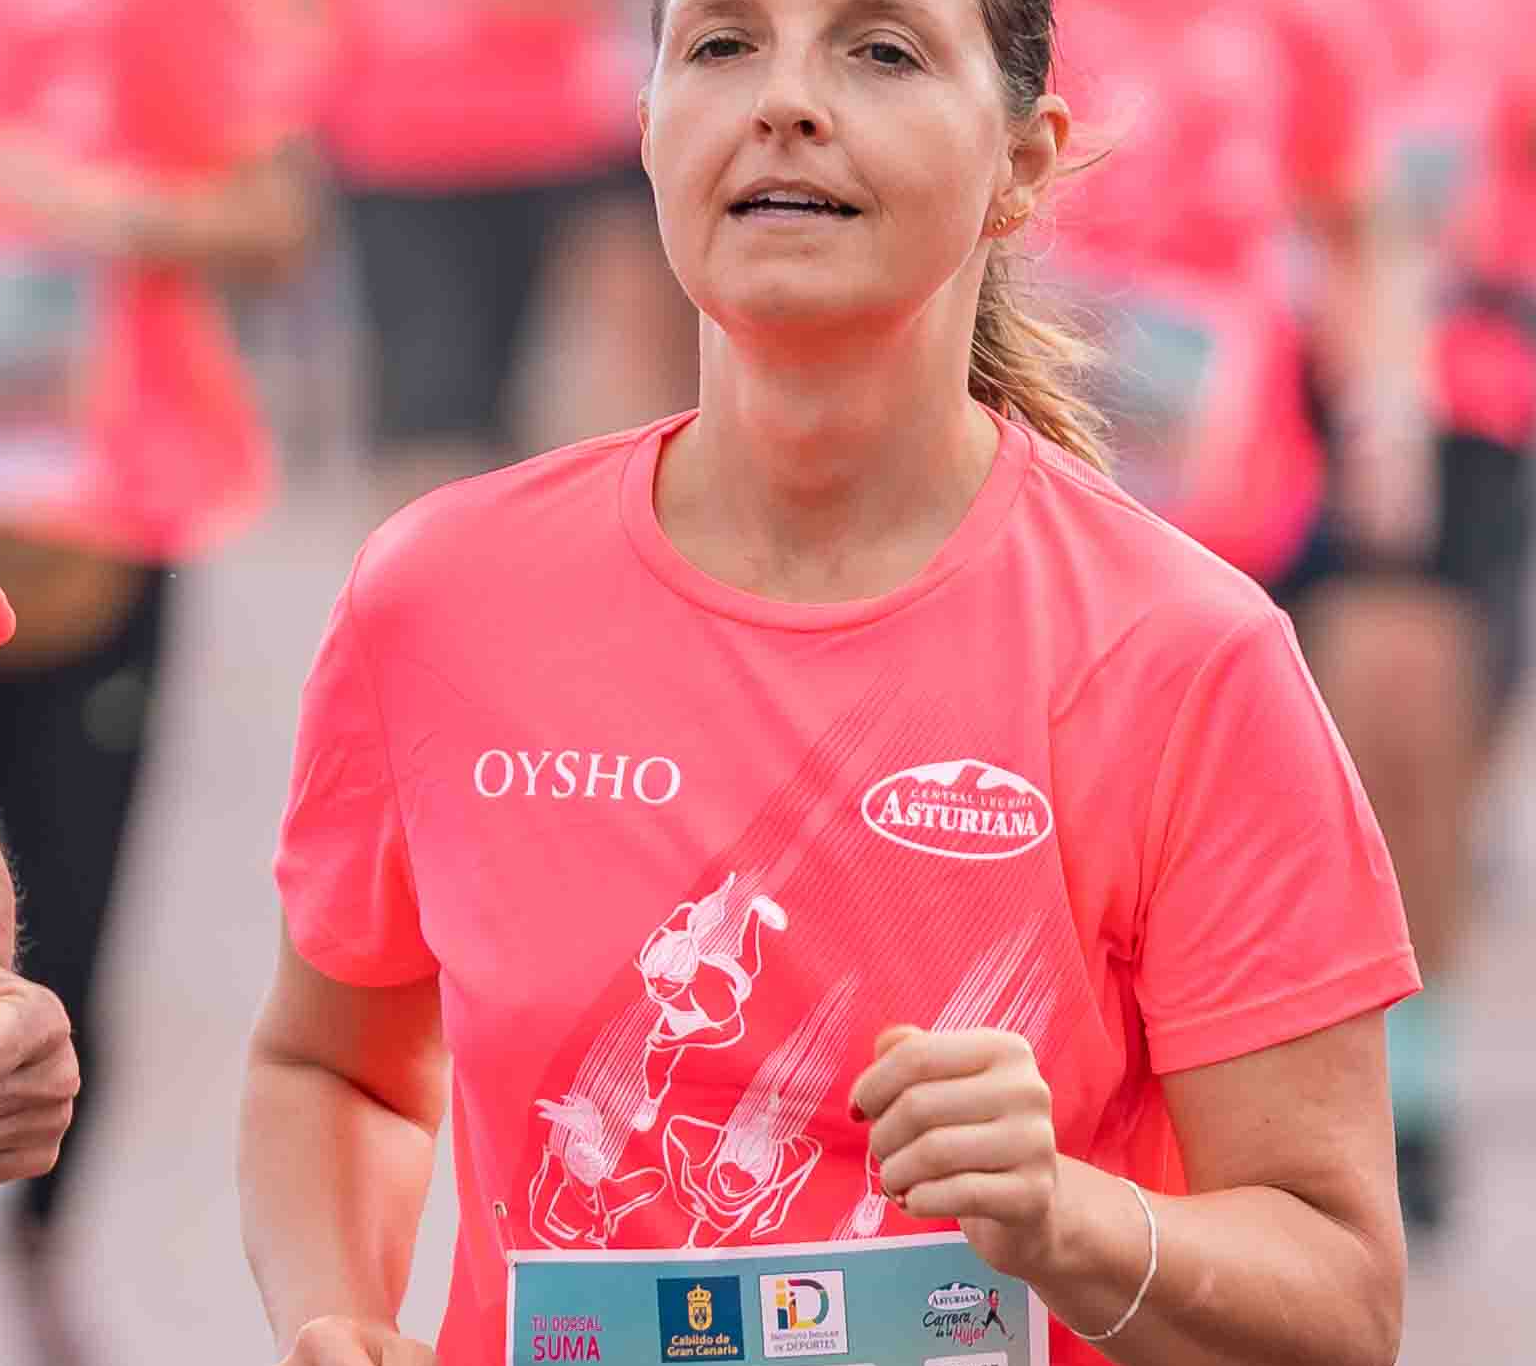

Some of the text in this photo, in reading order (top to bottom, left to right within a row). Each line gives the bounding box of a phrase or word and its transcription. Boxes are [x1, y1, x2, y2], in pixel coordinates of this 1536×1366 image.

[474, 748, 681, 805] OYSHO
[532, 1314, 603, 1332] TU DORSAL
[671, 1333, 730, 1345] Cabildo de
[532, 1335, 601, 1362] SUMA
[667, 1344, 738, 1356] Gran Canaria
